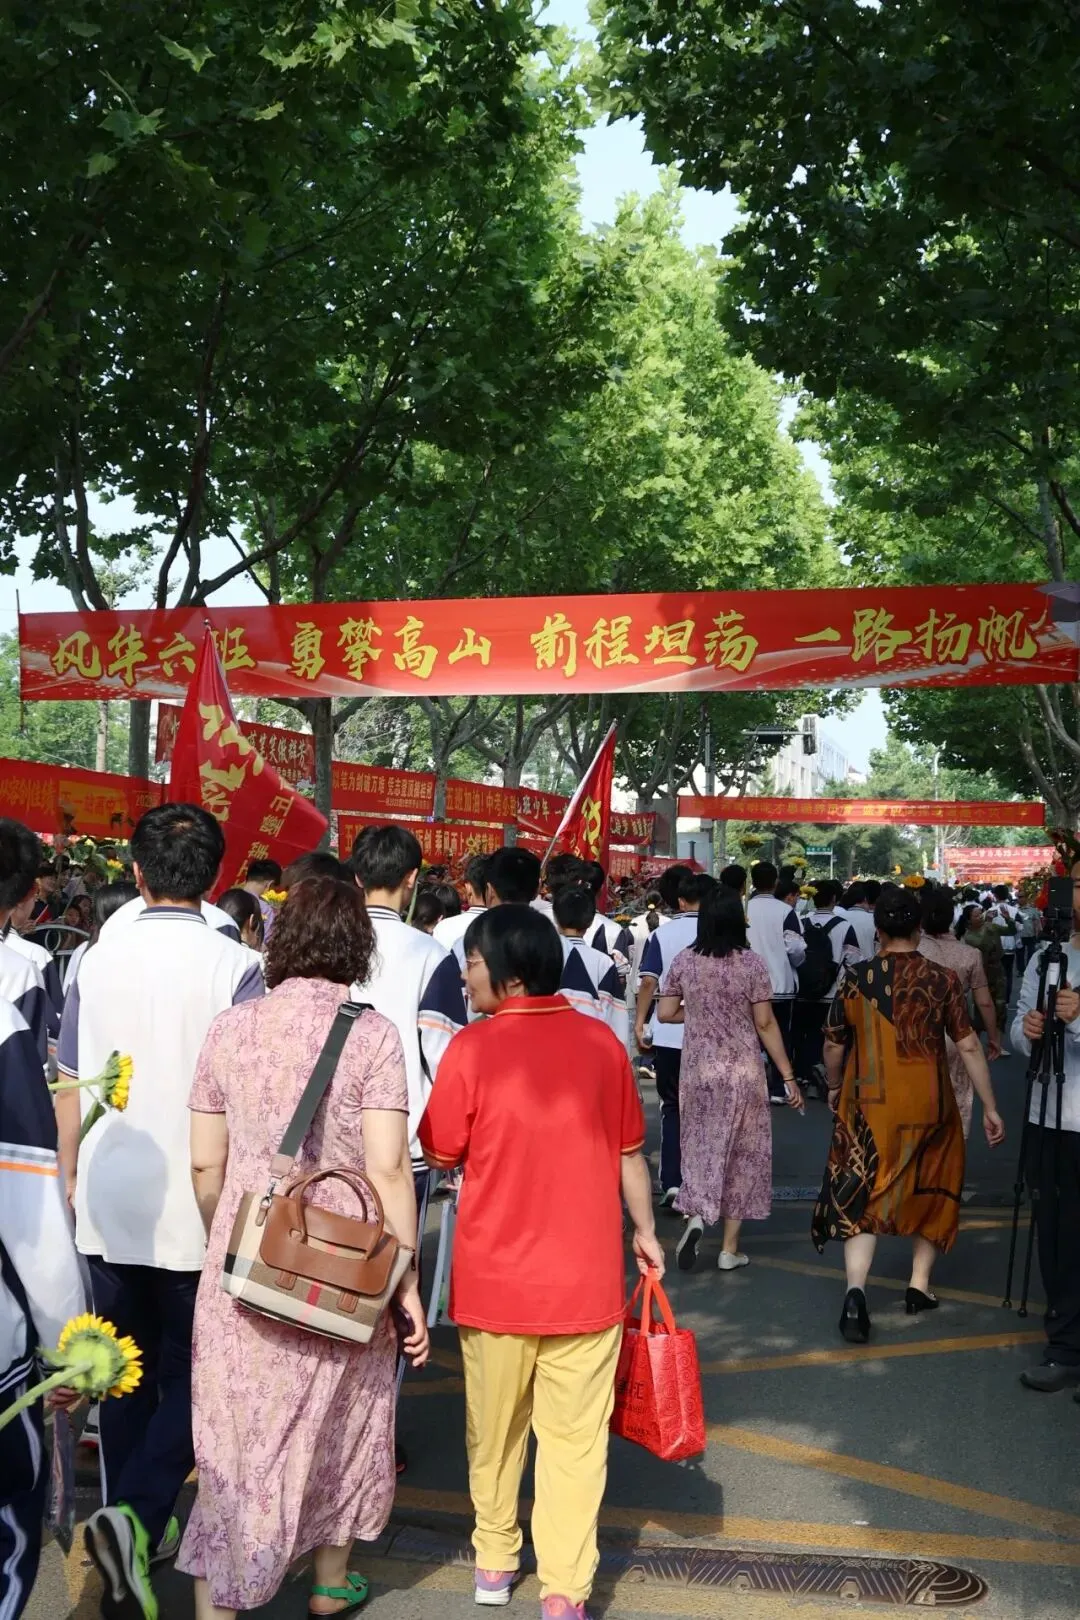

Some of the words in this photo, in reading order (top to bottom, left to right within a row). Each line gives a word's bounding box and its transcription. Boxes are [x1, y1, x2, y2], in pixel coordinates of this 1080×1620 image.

[52, 625, 256, 686] 风华六班
[290, 617, 492, 681] 勇攀高山
[531, 610, 759, 677] 前程坦荡
[794, 605, 1039, 664] 一路扬帆
